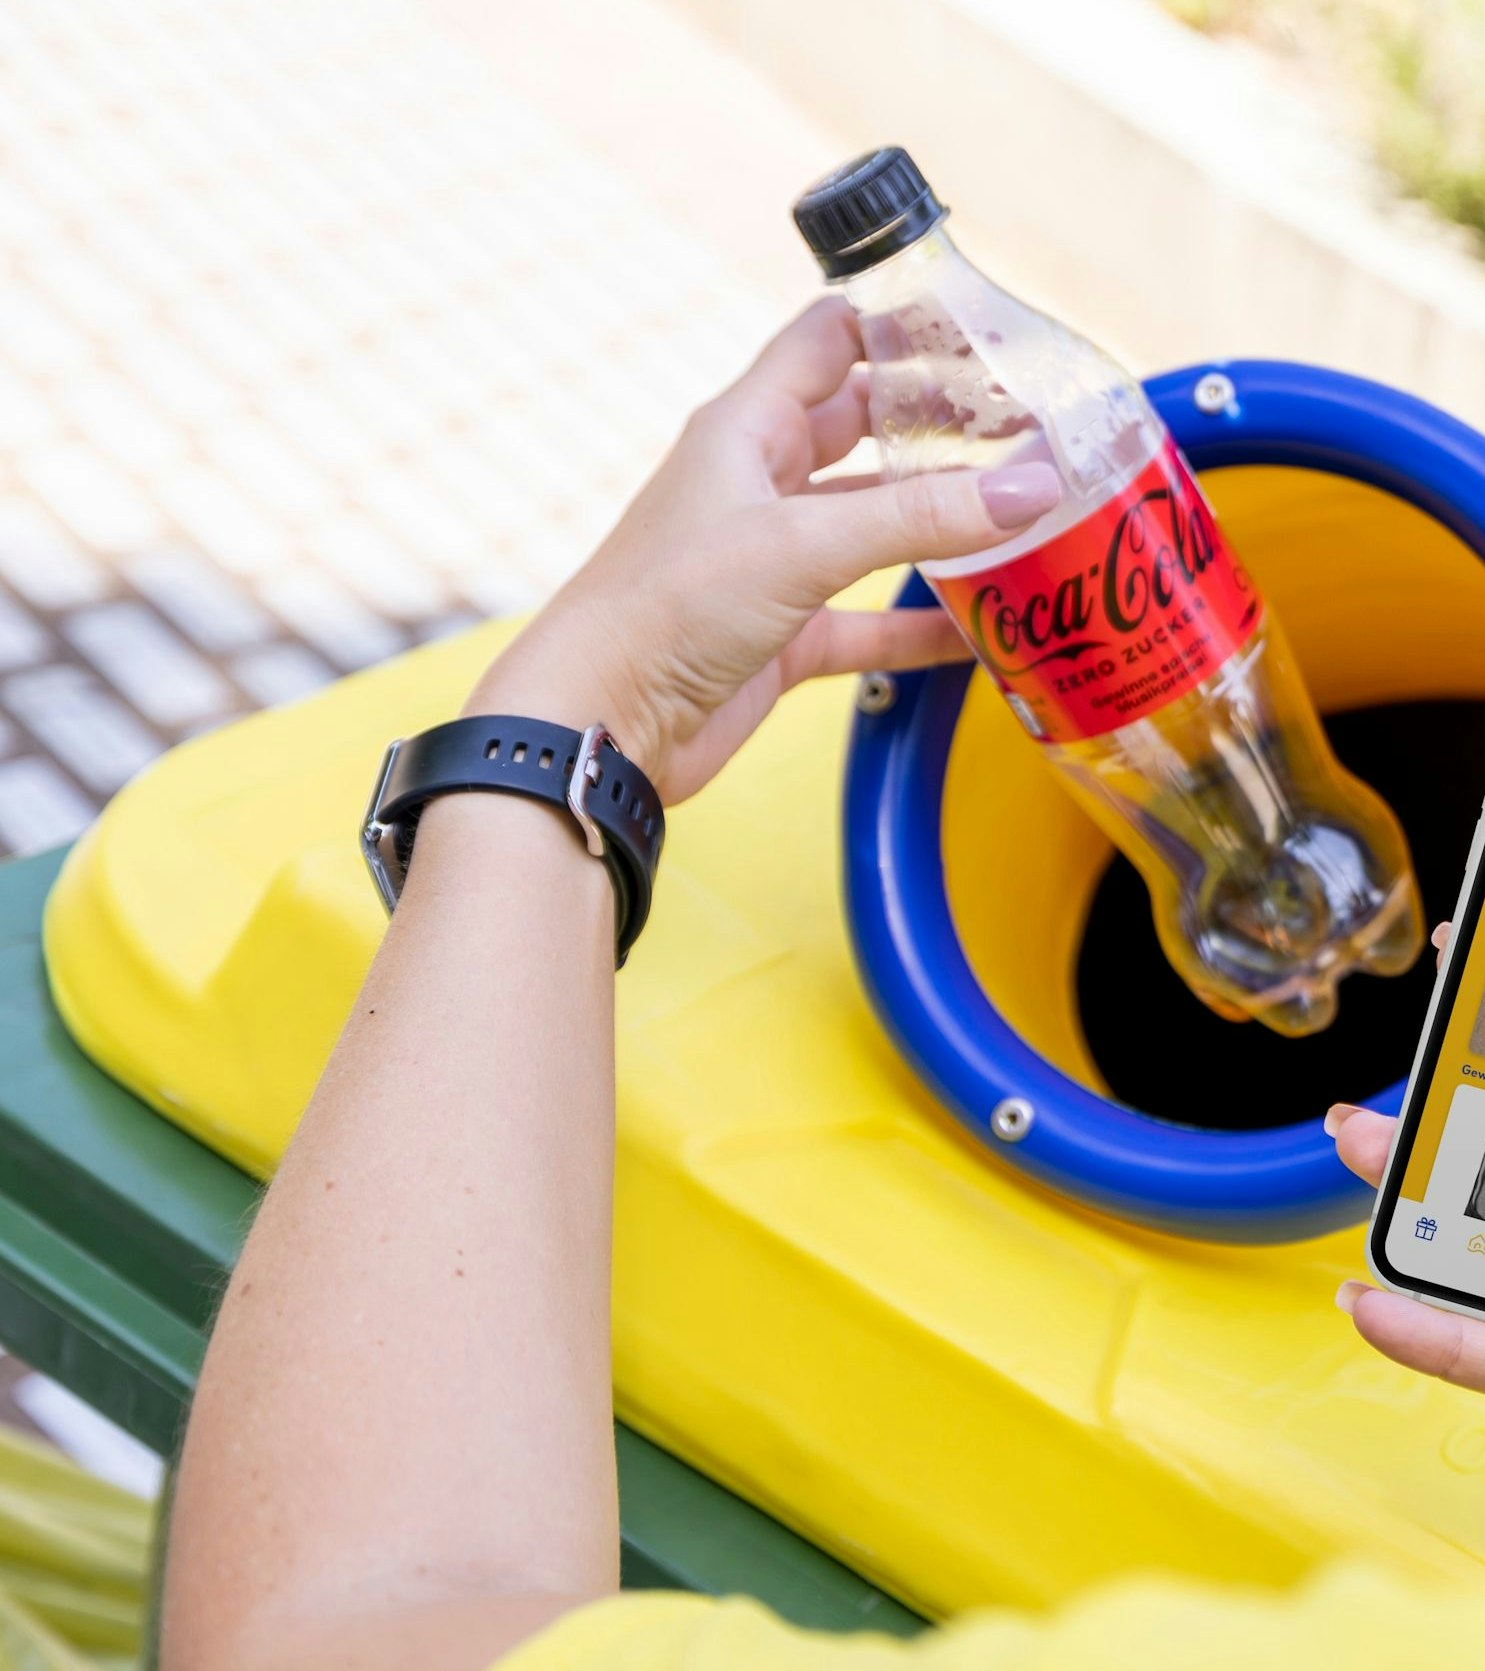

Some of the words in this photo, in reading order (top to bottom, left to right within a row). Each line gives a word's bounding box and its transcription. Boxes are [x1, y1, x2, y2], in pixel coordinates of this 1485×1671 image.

[970, 489, 1213, 675] Coca-Cola
[1052, 661, 1115, 694] ZERO
[1122, 596, 1205, 664] ZUCKER
